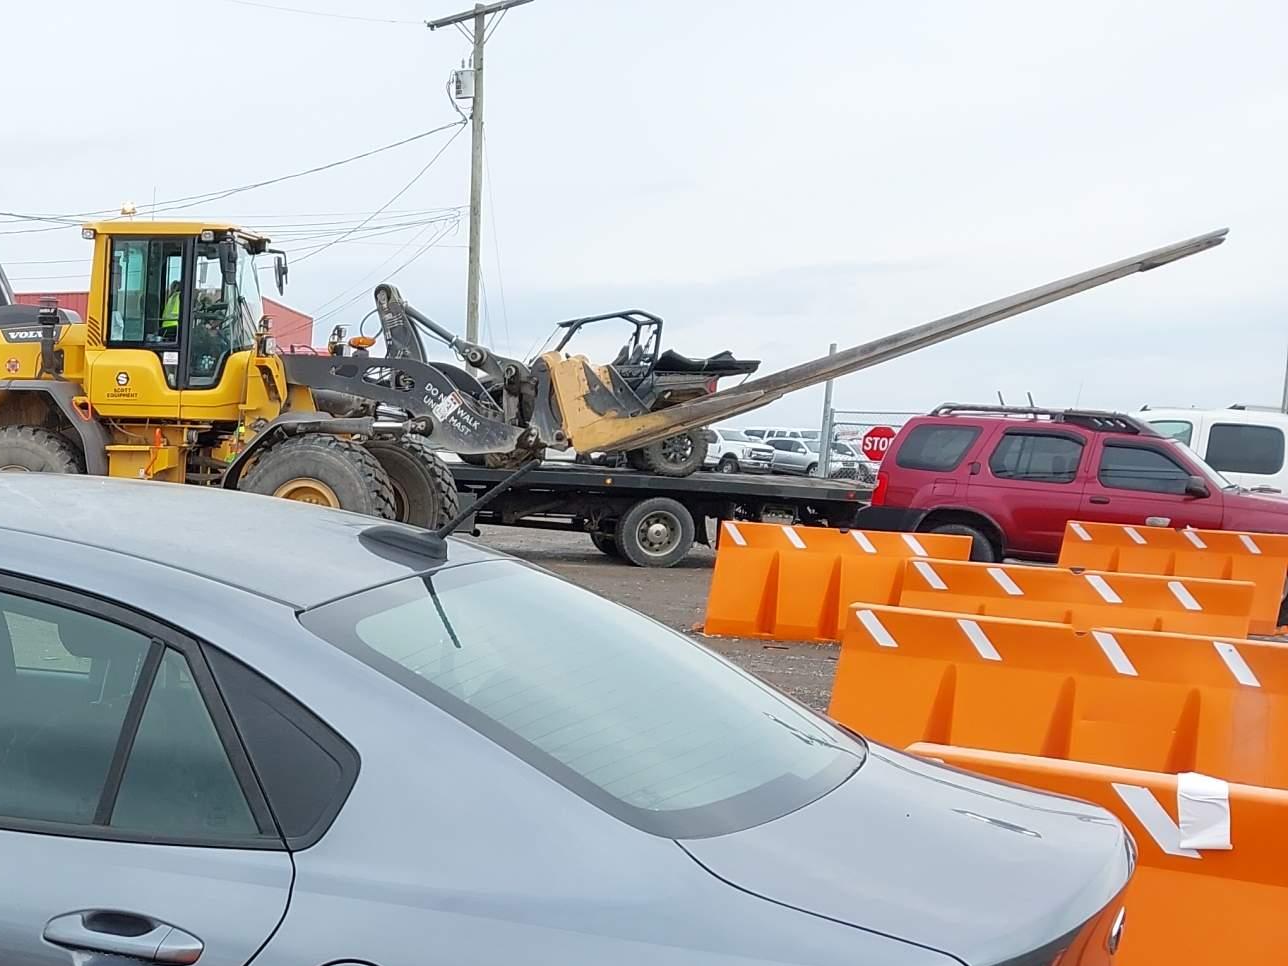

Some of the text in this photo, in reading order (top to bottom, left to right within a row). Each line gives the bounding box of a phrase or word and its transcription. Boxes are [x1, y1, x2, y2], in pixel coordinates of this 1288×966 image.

[424, 382, 481, 430] DO WALK
[448, 416, 472, 435] MAST
